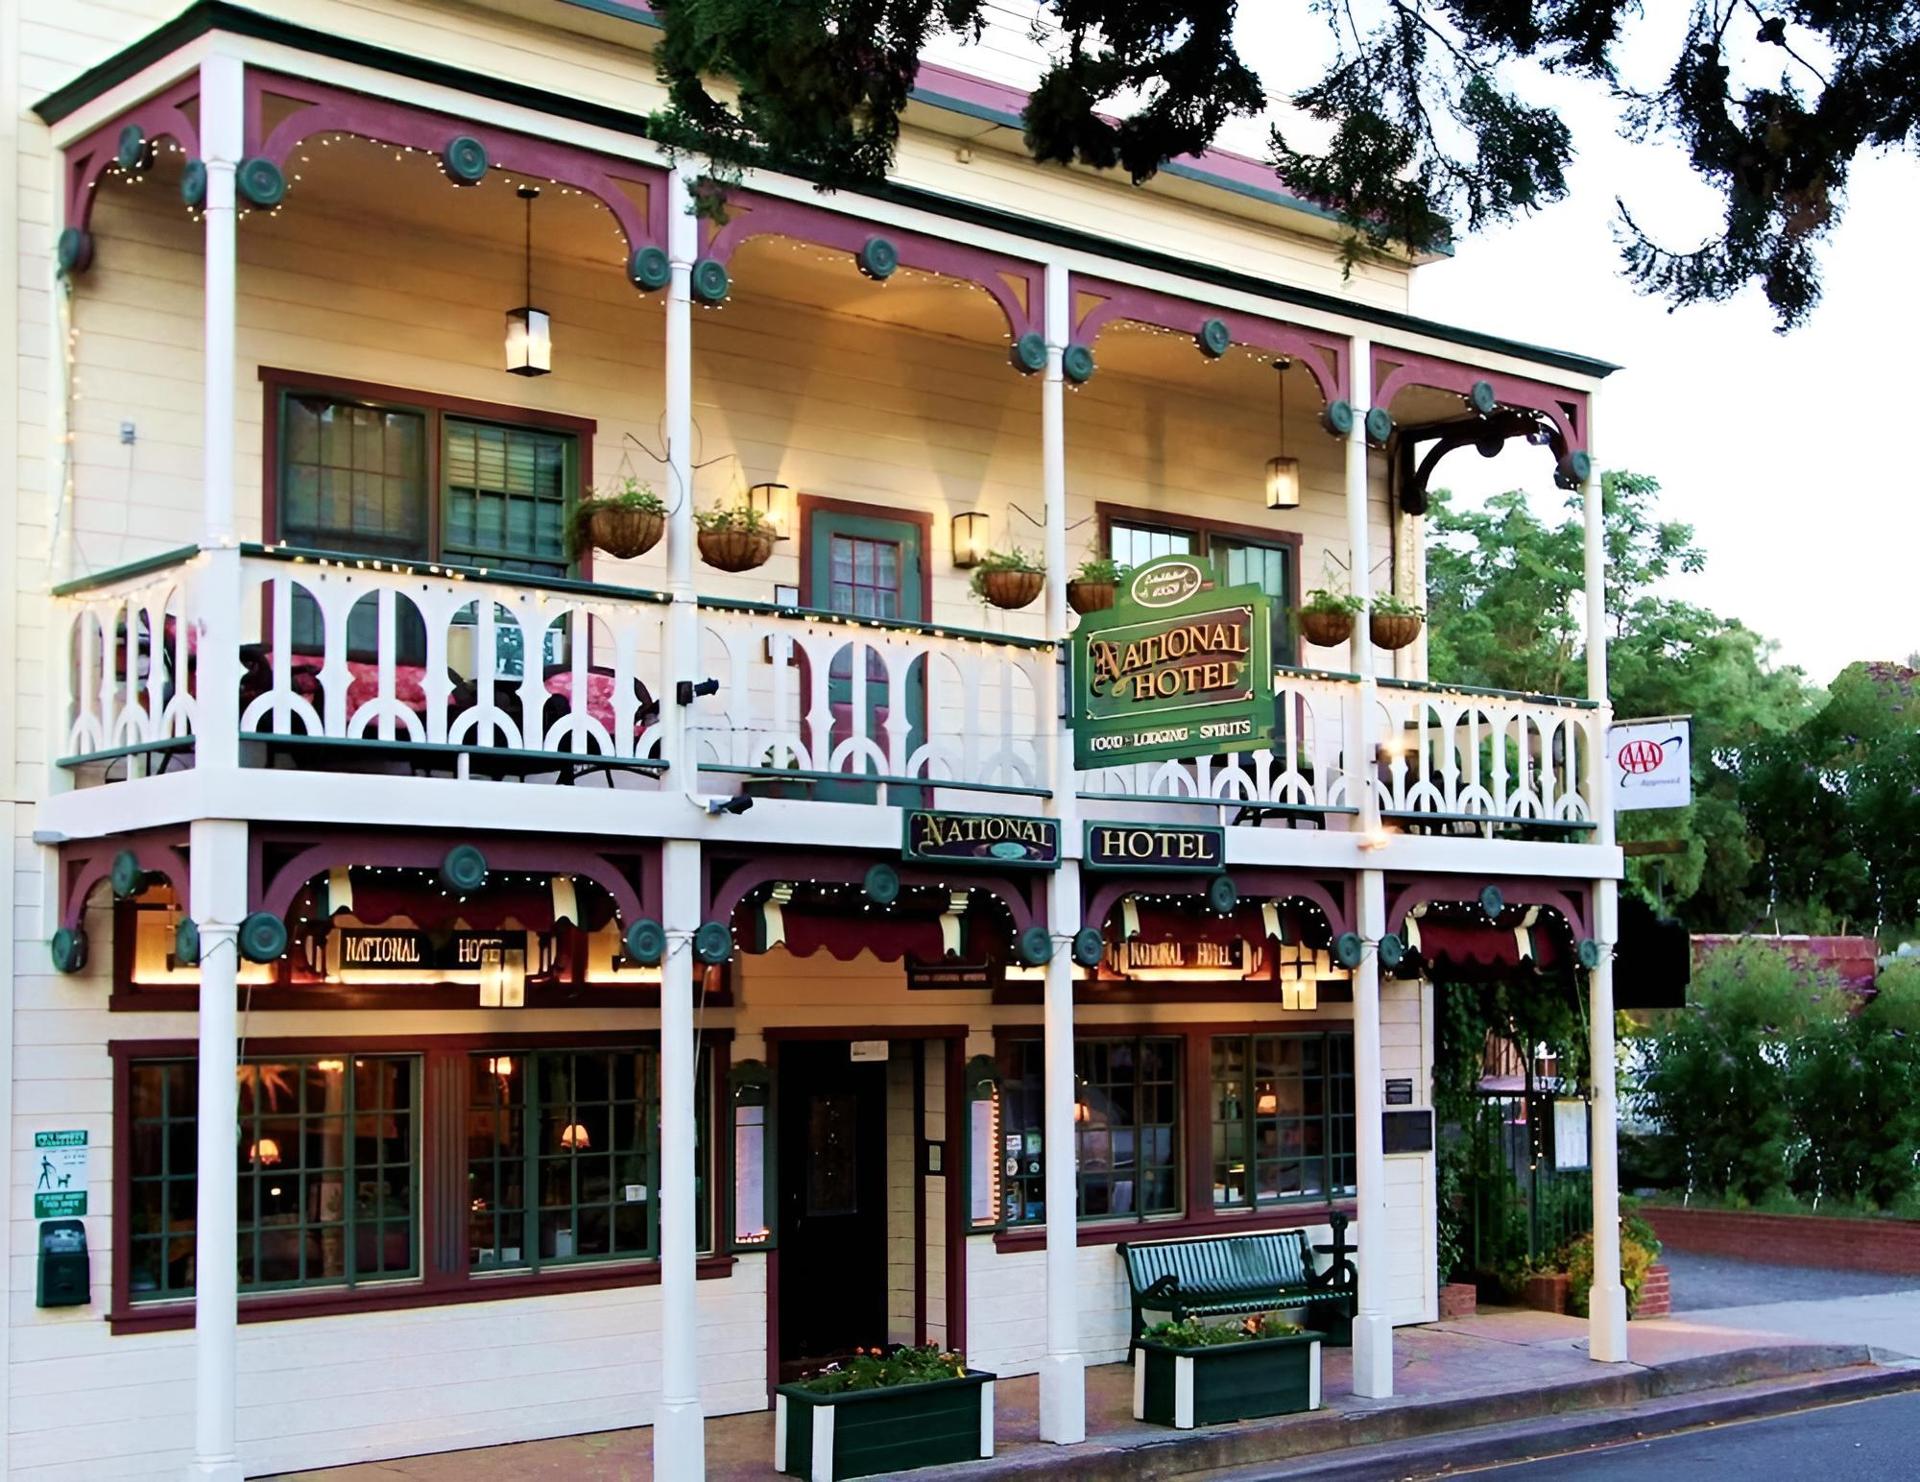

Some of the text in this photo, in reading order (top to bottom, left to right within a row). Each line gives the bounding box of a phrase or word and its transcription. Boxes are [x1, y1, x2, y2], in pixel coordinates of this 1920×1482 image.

[1092, 624, 1250, 688] NATIONAL
[1134, 662, 1240, 699] HOTEL
[1619, 741, 1663, 775] AAA
[919, 812, 1214, 861] NATIONAL HOTEL
[345, 936, 421, 962] NATIONAL
